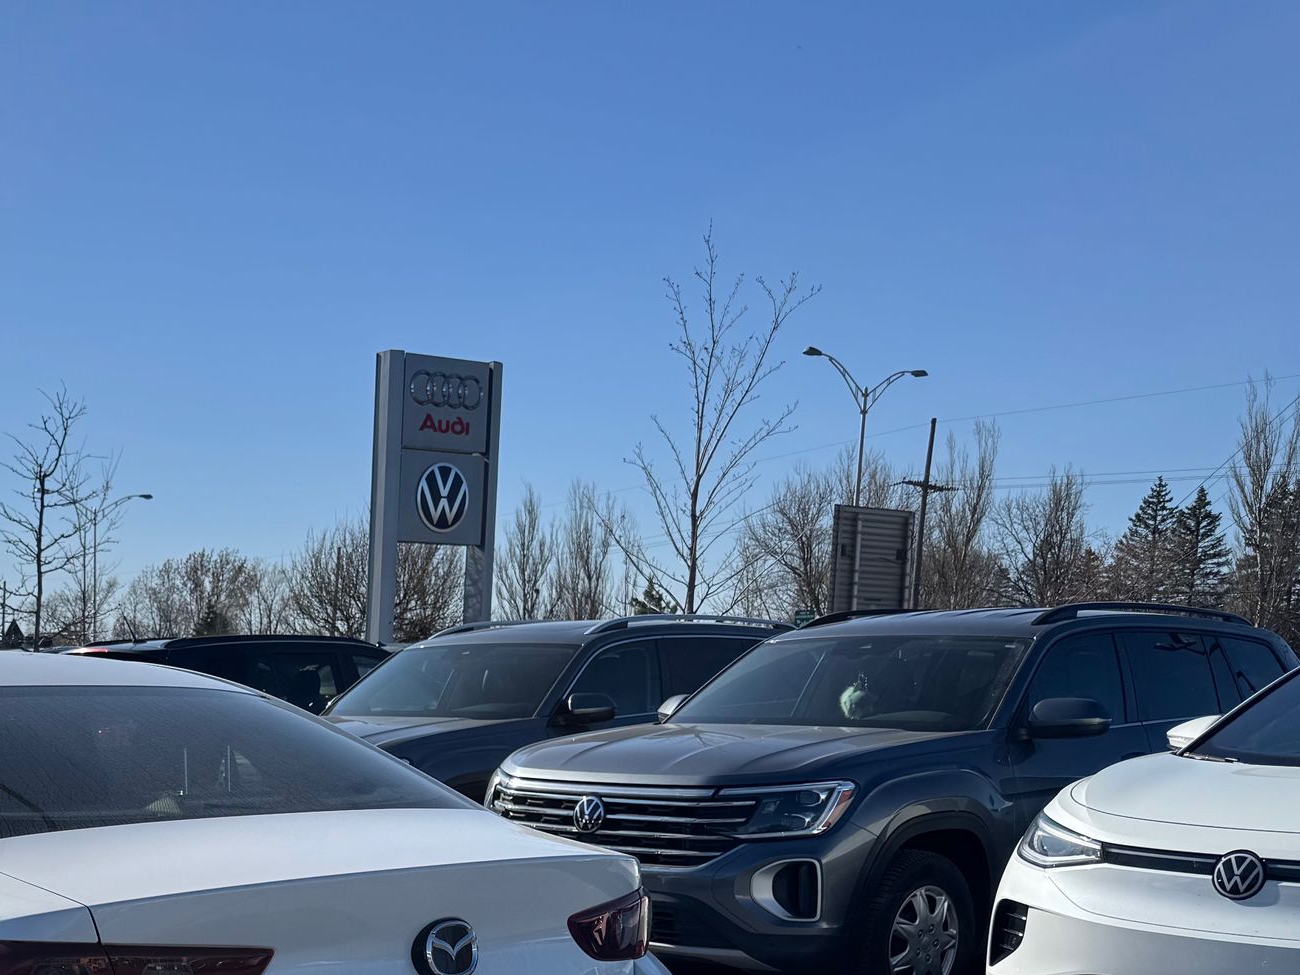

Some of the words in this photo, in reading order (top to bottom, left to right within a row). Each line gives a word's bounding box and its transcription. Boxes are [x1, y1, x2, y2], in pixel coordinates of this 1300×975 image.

[418, 413, 470, 436] Audi
[419, 463, 468, 530] VW
[574, 796, 604, 832] VW
[1215, 854, 1262, 896] VW
